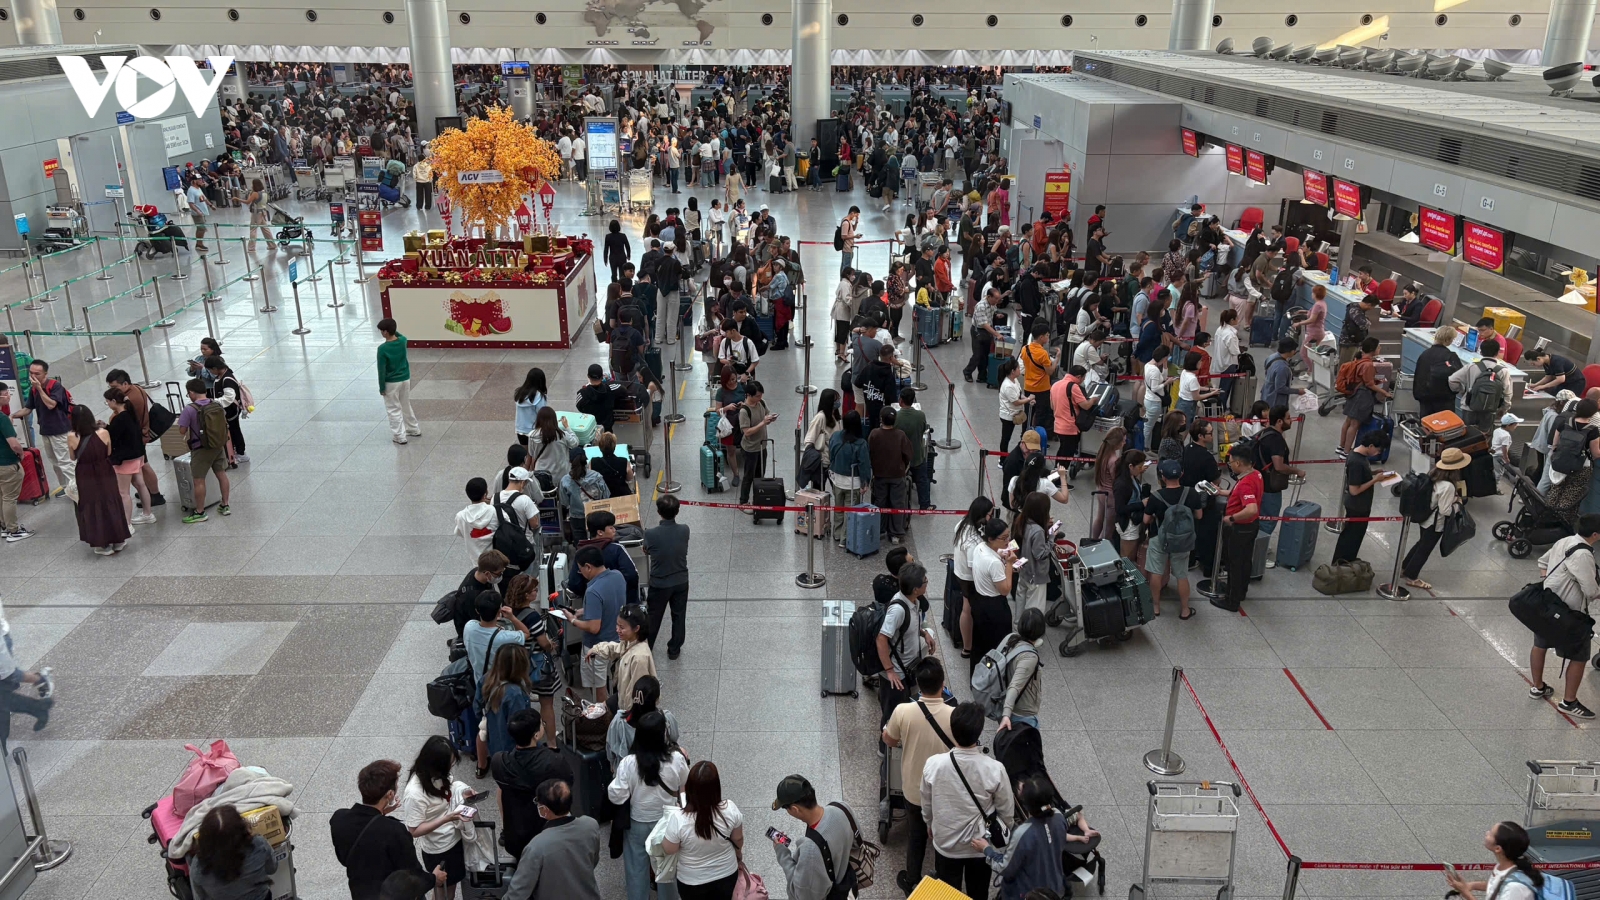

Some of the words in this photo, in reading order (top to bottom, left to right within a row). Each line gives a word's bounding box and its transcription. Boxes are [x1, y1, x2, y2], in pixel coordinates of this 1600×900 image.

[1436, 185, 1446, 196] G-5
[1482, 198, 1493, 209] G-4
[417, 244, 470, 268] XUÂN
